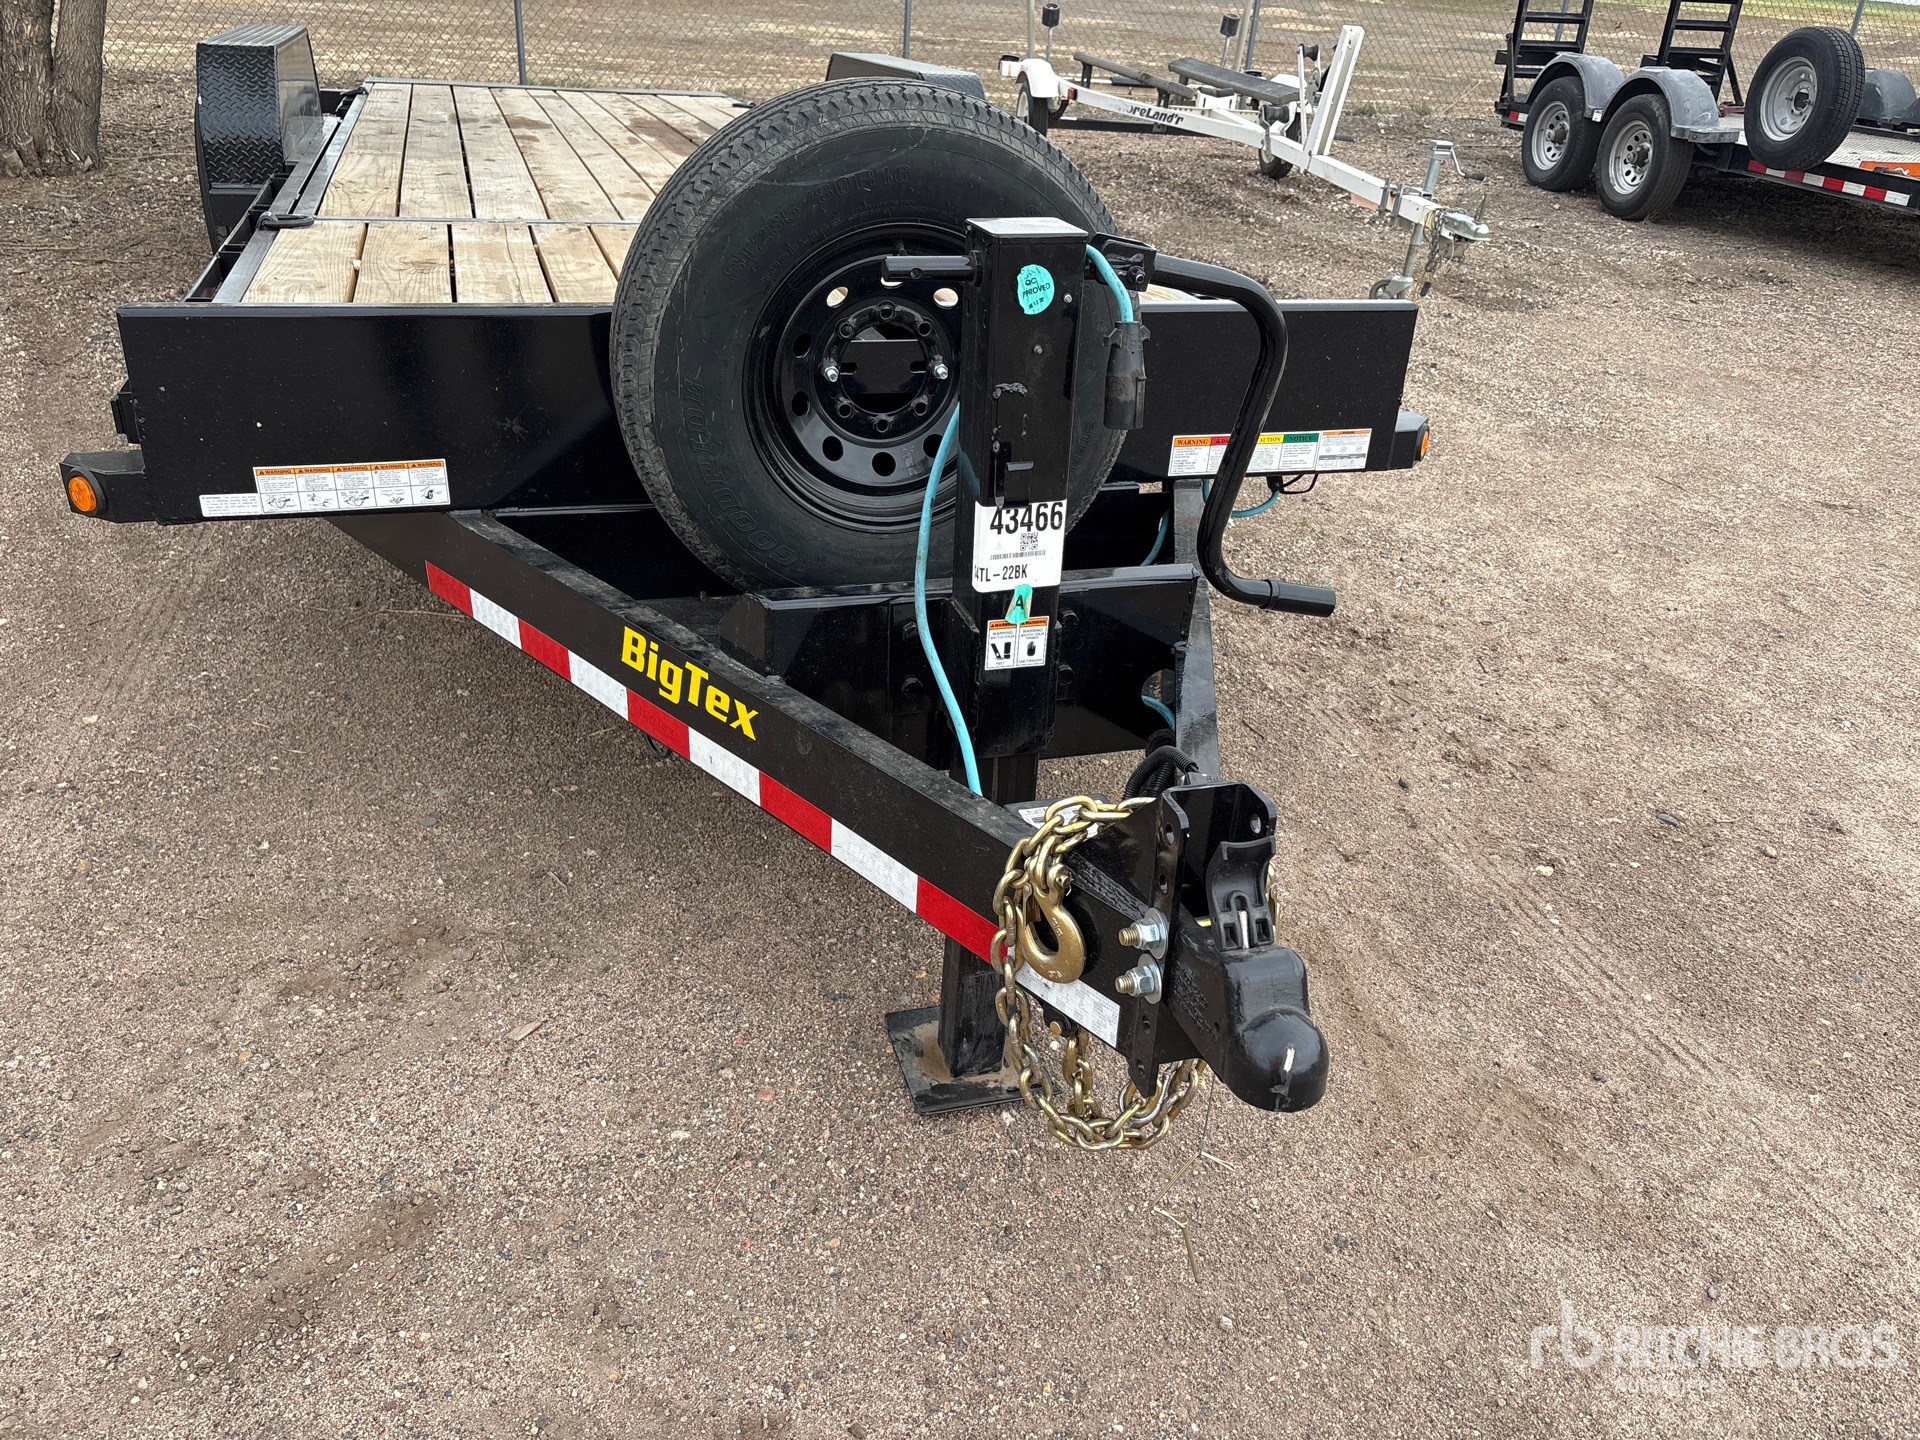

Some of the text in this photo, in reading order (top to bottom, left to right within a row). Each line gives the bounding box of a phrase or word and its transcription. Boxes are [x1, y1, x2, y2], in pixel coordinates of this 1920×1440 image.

[1118, 103, 1185, 125] oreLand'r
[990, 501, 1064, 535] 43466
[1013, 594, 1024, 610] A
[621, 625, 759, 741] BigTex
